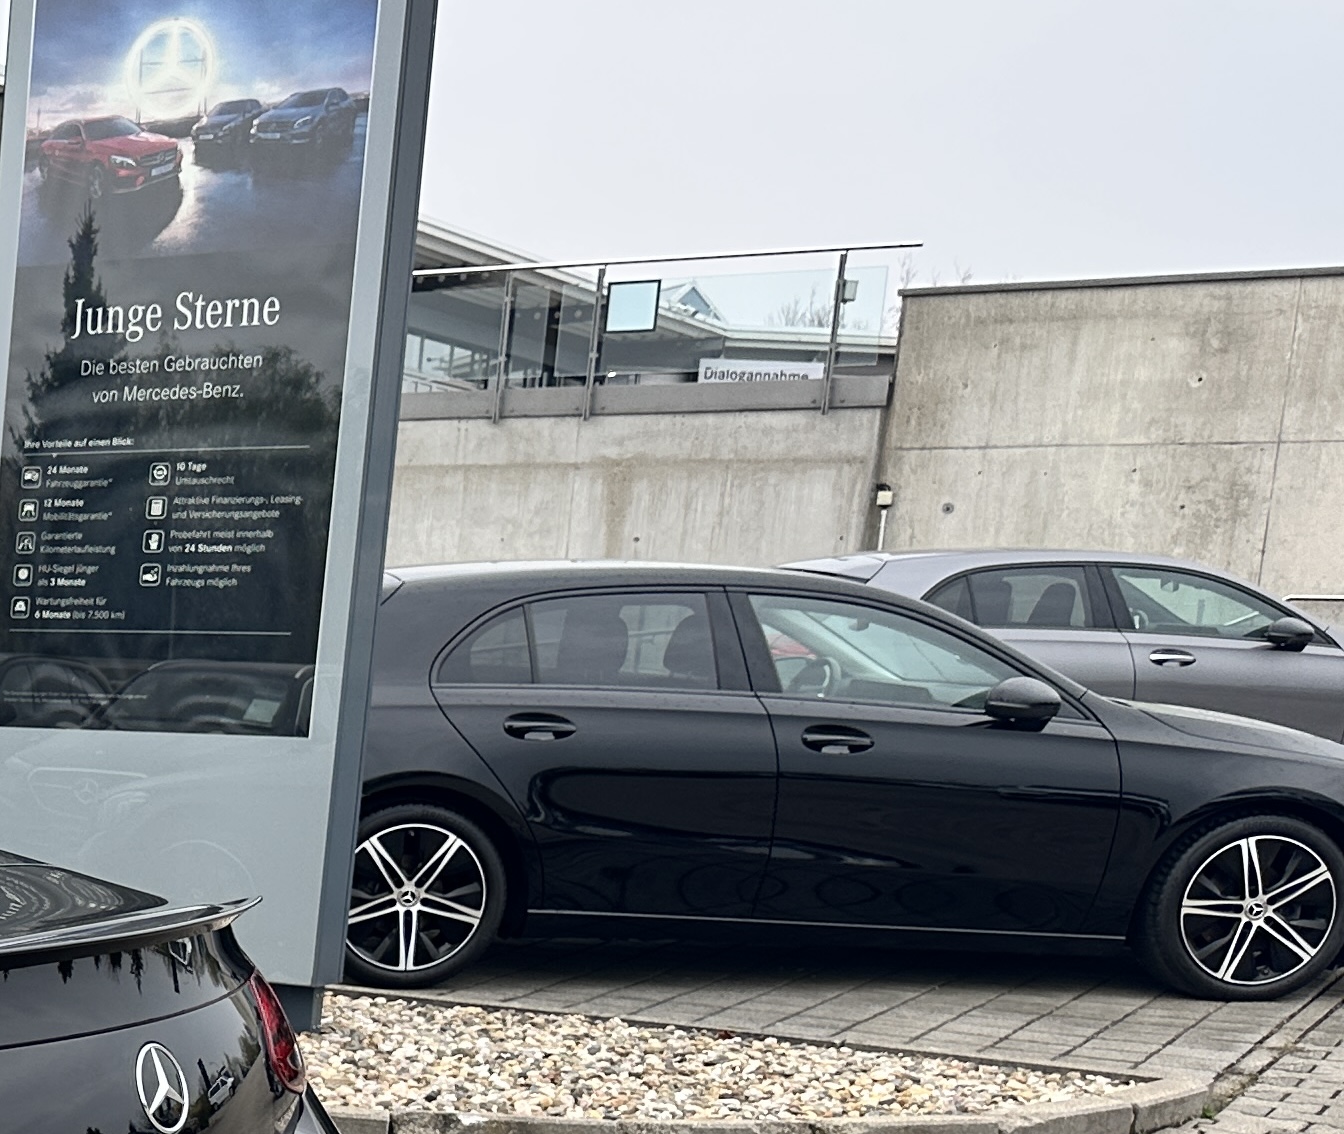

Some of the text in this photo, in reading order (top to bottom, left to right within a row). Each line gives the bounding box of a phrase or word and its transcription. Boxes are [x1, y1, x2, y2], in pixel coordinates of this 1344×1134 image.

[71, 291, 281, 342] Junge Sterne
[81, 353, 263, 376] Die besten Gebrauchten
[703, 366, 809, 382] Dialogannahme
[92, 382, 245, 403] von Mercedes-Benz.
[24, 437, 134, 449] Ihre Vorteile auf einen Blick:
[47, 466, 88, 474] 24 Monate
[176, 462, 207, 473] 10 Tage
[44, 499, 84, 508] 12 Monate
[172, 510, 280, 521] und Versicherungsangebote
[170, 530, 211, 539] Probefahrt
[236, 529, 274, 538] innerhalb
[168, 544, 266, 555] von 24 Stunden möglich
[37, 578, 86, 587] als 3 Monate
[206, 577, 238, 589] möglich
[34, 610, 41, 619] 6
[42, 610, 71, 619] Monate
